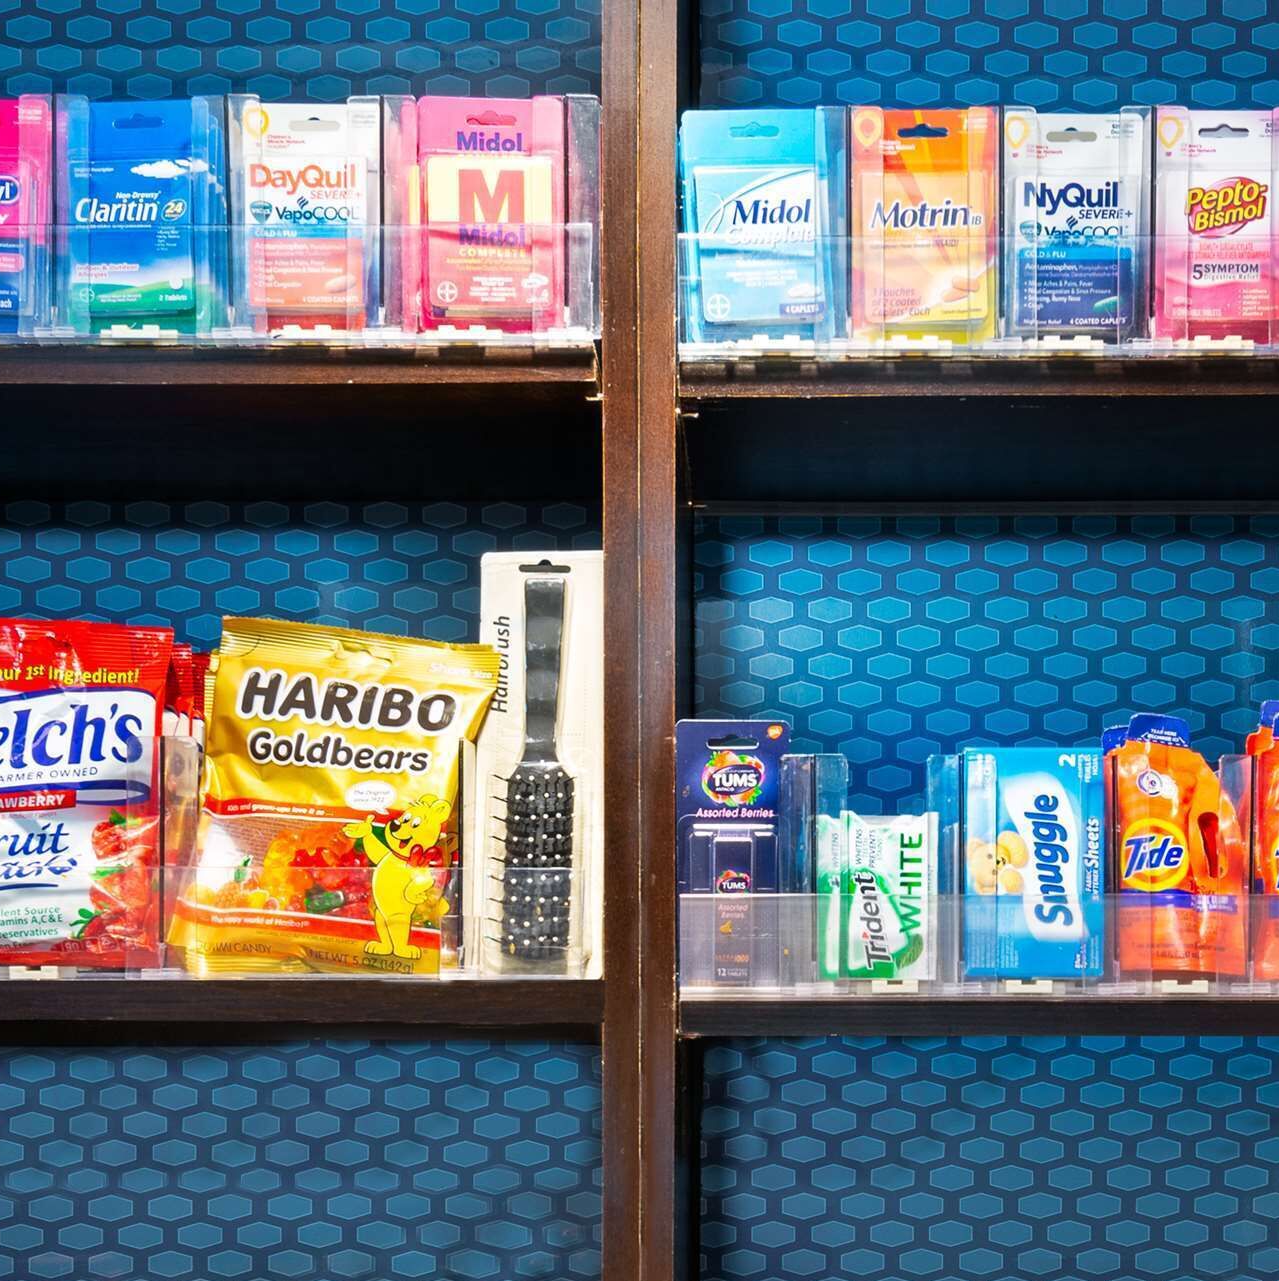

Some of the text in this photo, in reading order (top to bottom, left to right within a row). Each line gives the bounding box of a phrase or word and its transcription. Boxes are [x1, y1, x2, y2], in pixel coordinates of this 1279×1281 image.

[457, 131, 522, 152] Midol
[249, 164, 355, 195] DayQuil
[75, 198, 158, 223] Claritin
[459, 169, 525, 224] M
[733, 198, 811, 225] Midol
[1023, 182, 1119, 215] NyQuil
[1187, 183, 1268, 213] Pepto-
[871, 200, 970, 228] Motrin
[1194, 203, 1264, 231] Bismol
[1192, 264, 1259, 280] 5 SYMPTOM
[240, 670, 457, 731] HARIBO
[248, 732, 429, 772] Goldbears
[712, 773, 758, 787] TUMS
[696, 807, 774, 818] Assorted Berries
[1035, 793, 1069, 927] Snuggle
[1123, 833, 1183, 881] Tide
[899, 832, 923, 934] WHITE
[855, 871, 891, 970] Trident
